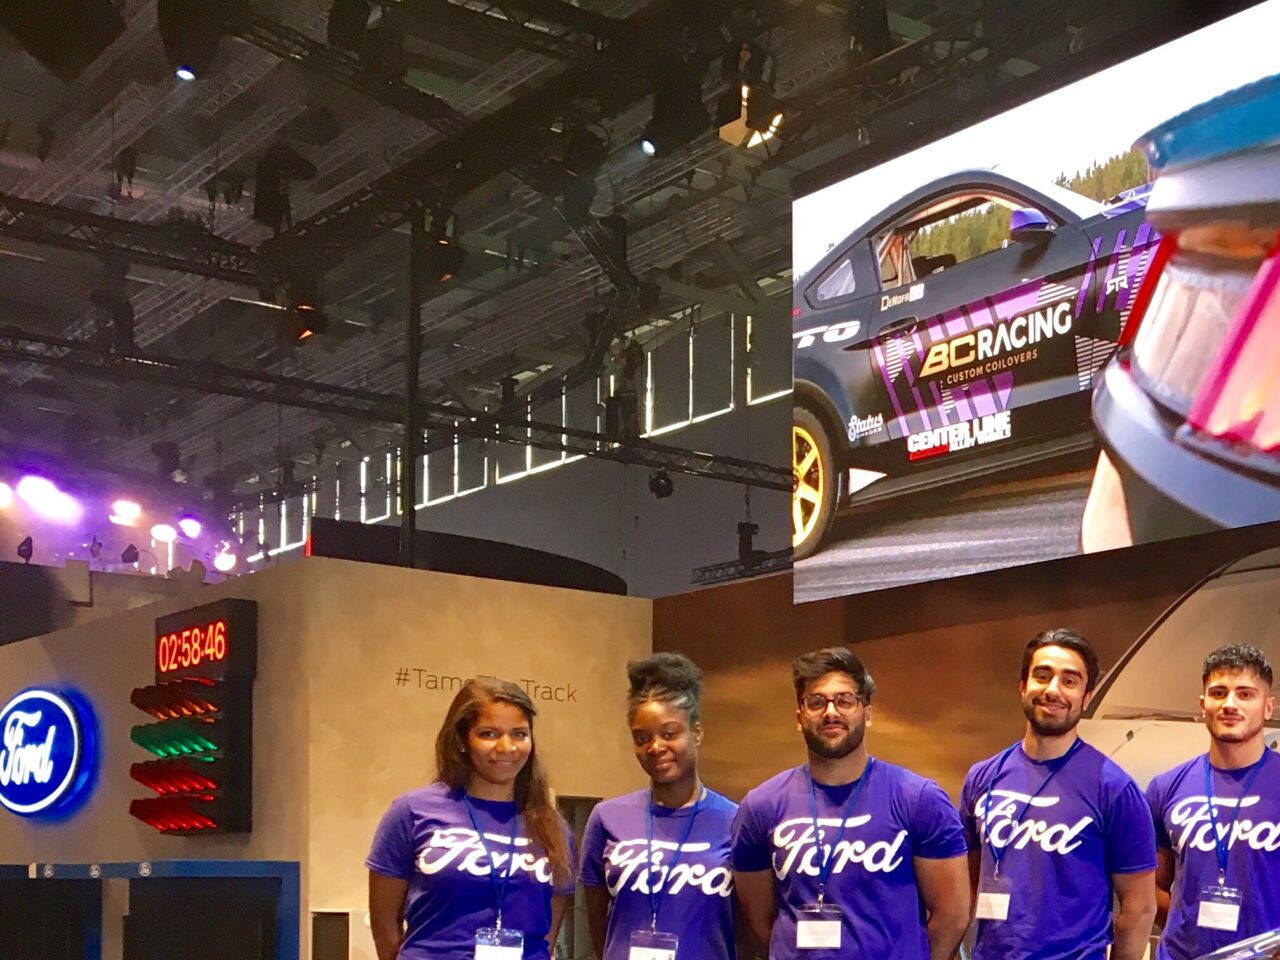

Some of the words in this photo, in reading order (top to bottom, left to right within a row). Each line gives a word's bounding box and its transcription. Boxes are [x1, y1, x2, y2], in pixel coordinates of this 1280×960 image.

[977, 302, 1072, 361] RACING
[946, 366, 984, 385] CUSTOM
[986, 348, 1038, 373] COILOVERS
[848, 412, 884, 442] Status
[907, 421, 970, 453] CENTER
[973, 410, 1011, 435] LINE
[158, 621, 227, 673] 02:58:46
[0, 710, 57, 787] Ford
[773, 814, 909, 882] Ford
[974, 789, 1094, 855] Ford
